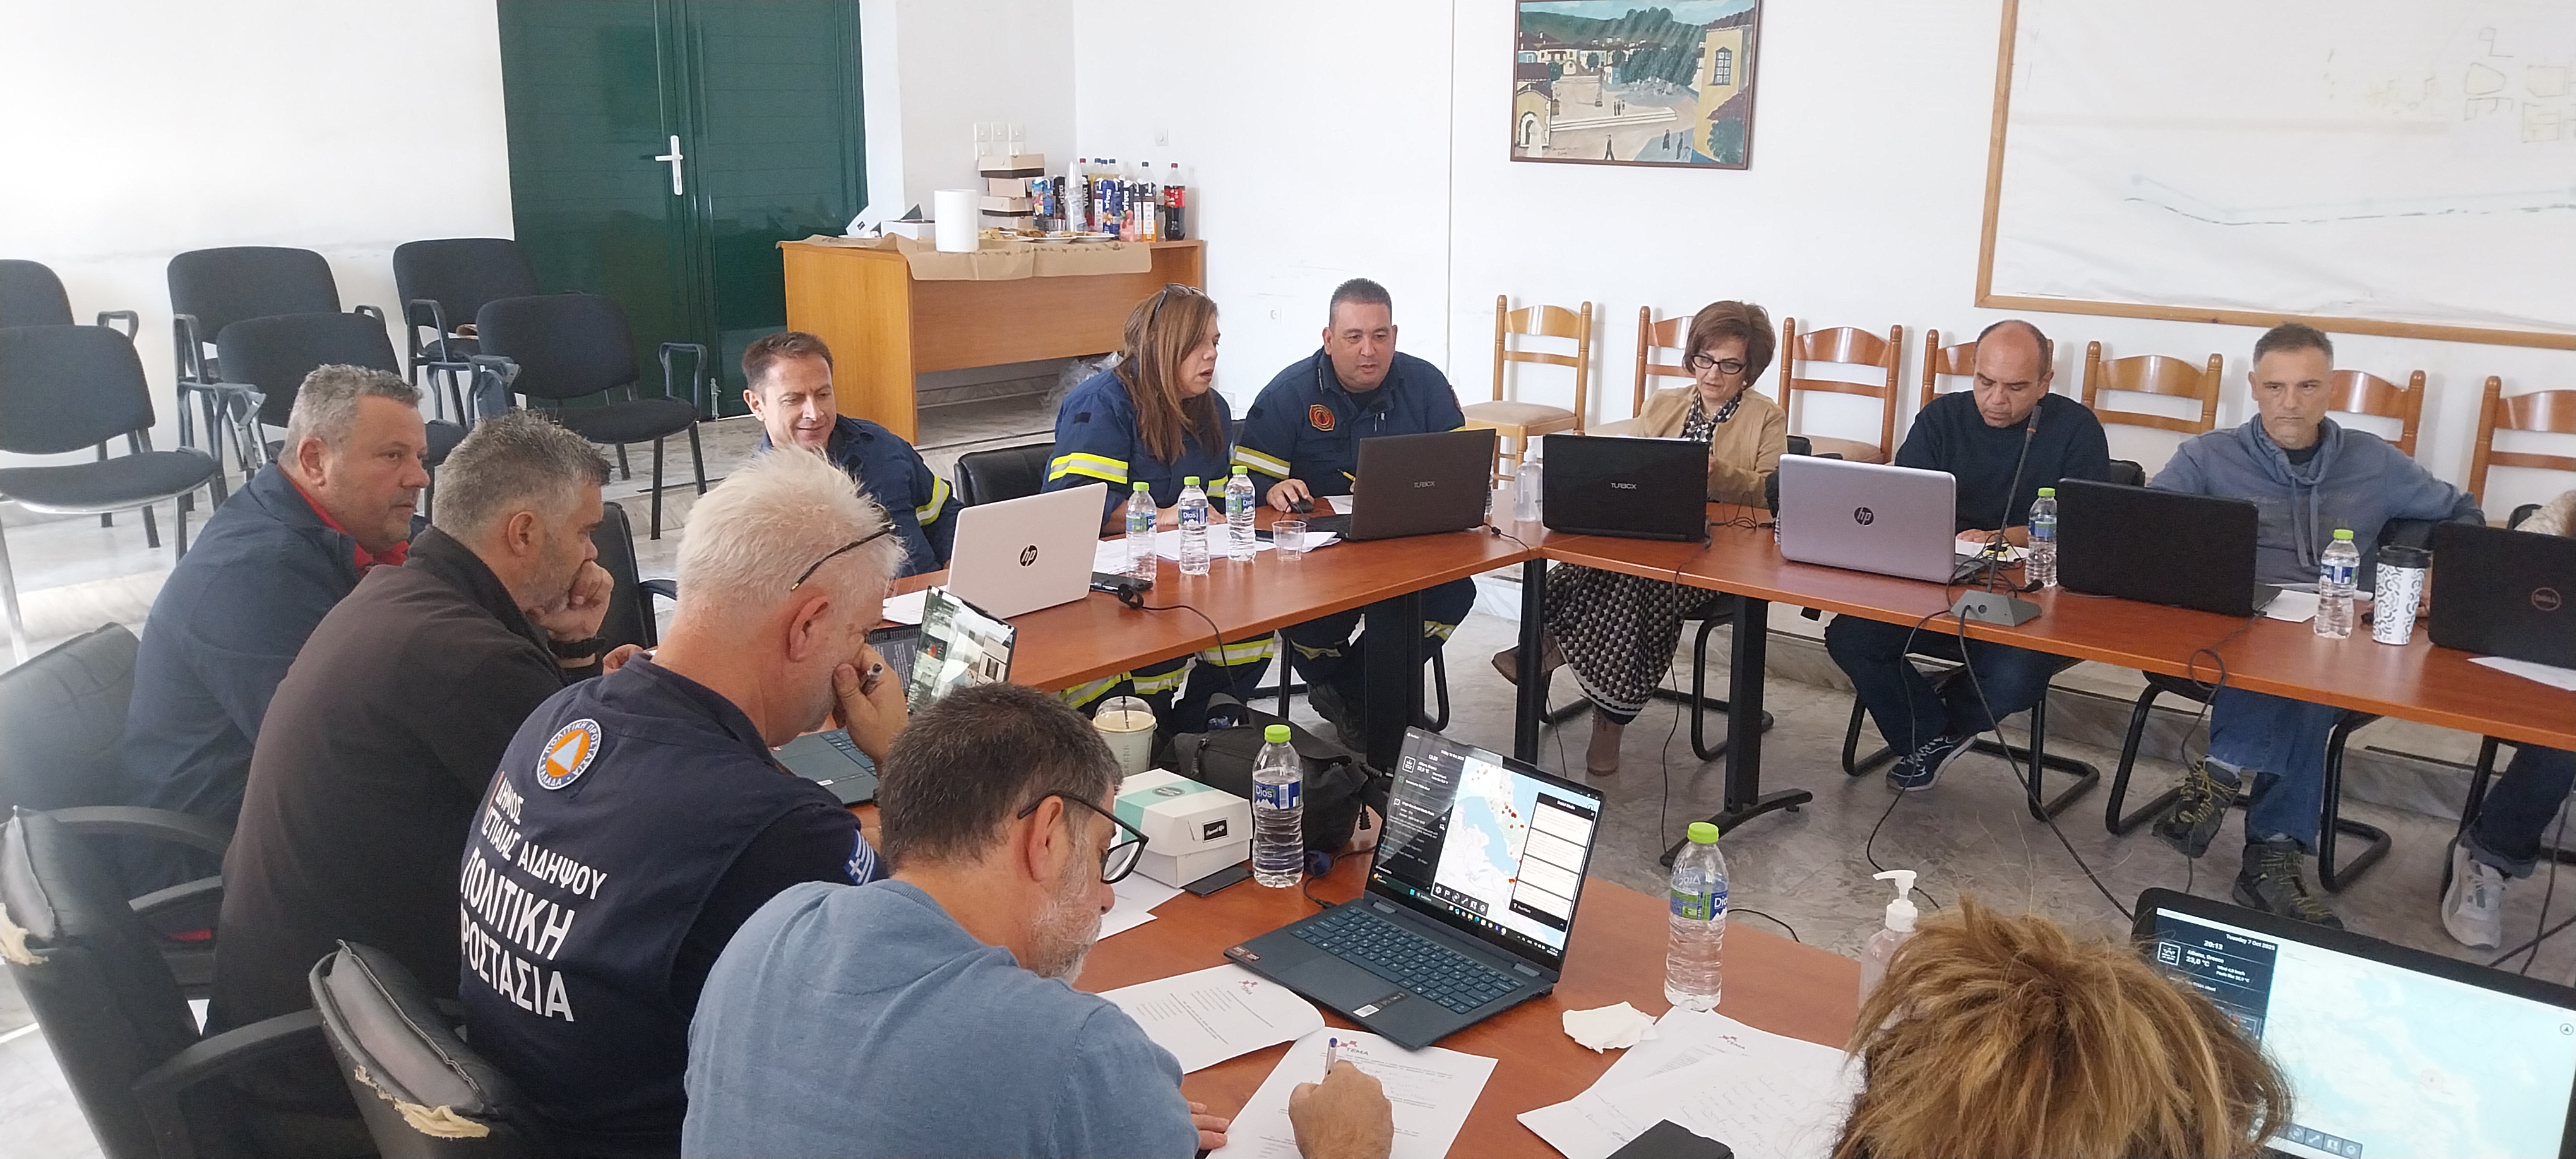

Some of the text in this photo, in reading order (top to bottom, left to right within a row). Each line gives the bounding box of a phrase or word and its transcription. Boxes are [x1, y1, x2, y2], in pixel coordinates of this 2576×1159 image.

[1855, 507, 1873, 525] hp
[1020, 545, 1037, 567] hp
[546, 722, 599, 776] ΠΟΛΙΤΙΚΗ ΠΡΟΣΤΑΣΙΑ
[540, 764, 562, 787] ΕΛΛΑΔΑ
[495, 777, 525, 825] ΔΗΜΟΣ
[517, 840, 608, 900] ΑΙΔΗΨΟΥ
[460, 847, 576, 961] ΠΟΛΙΤΙΚΗ
[1347, 1047, 1369, 1055] TEMA
